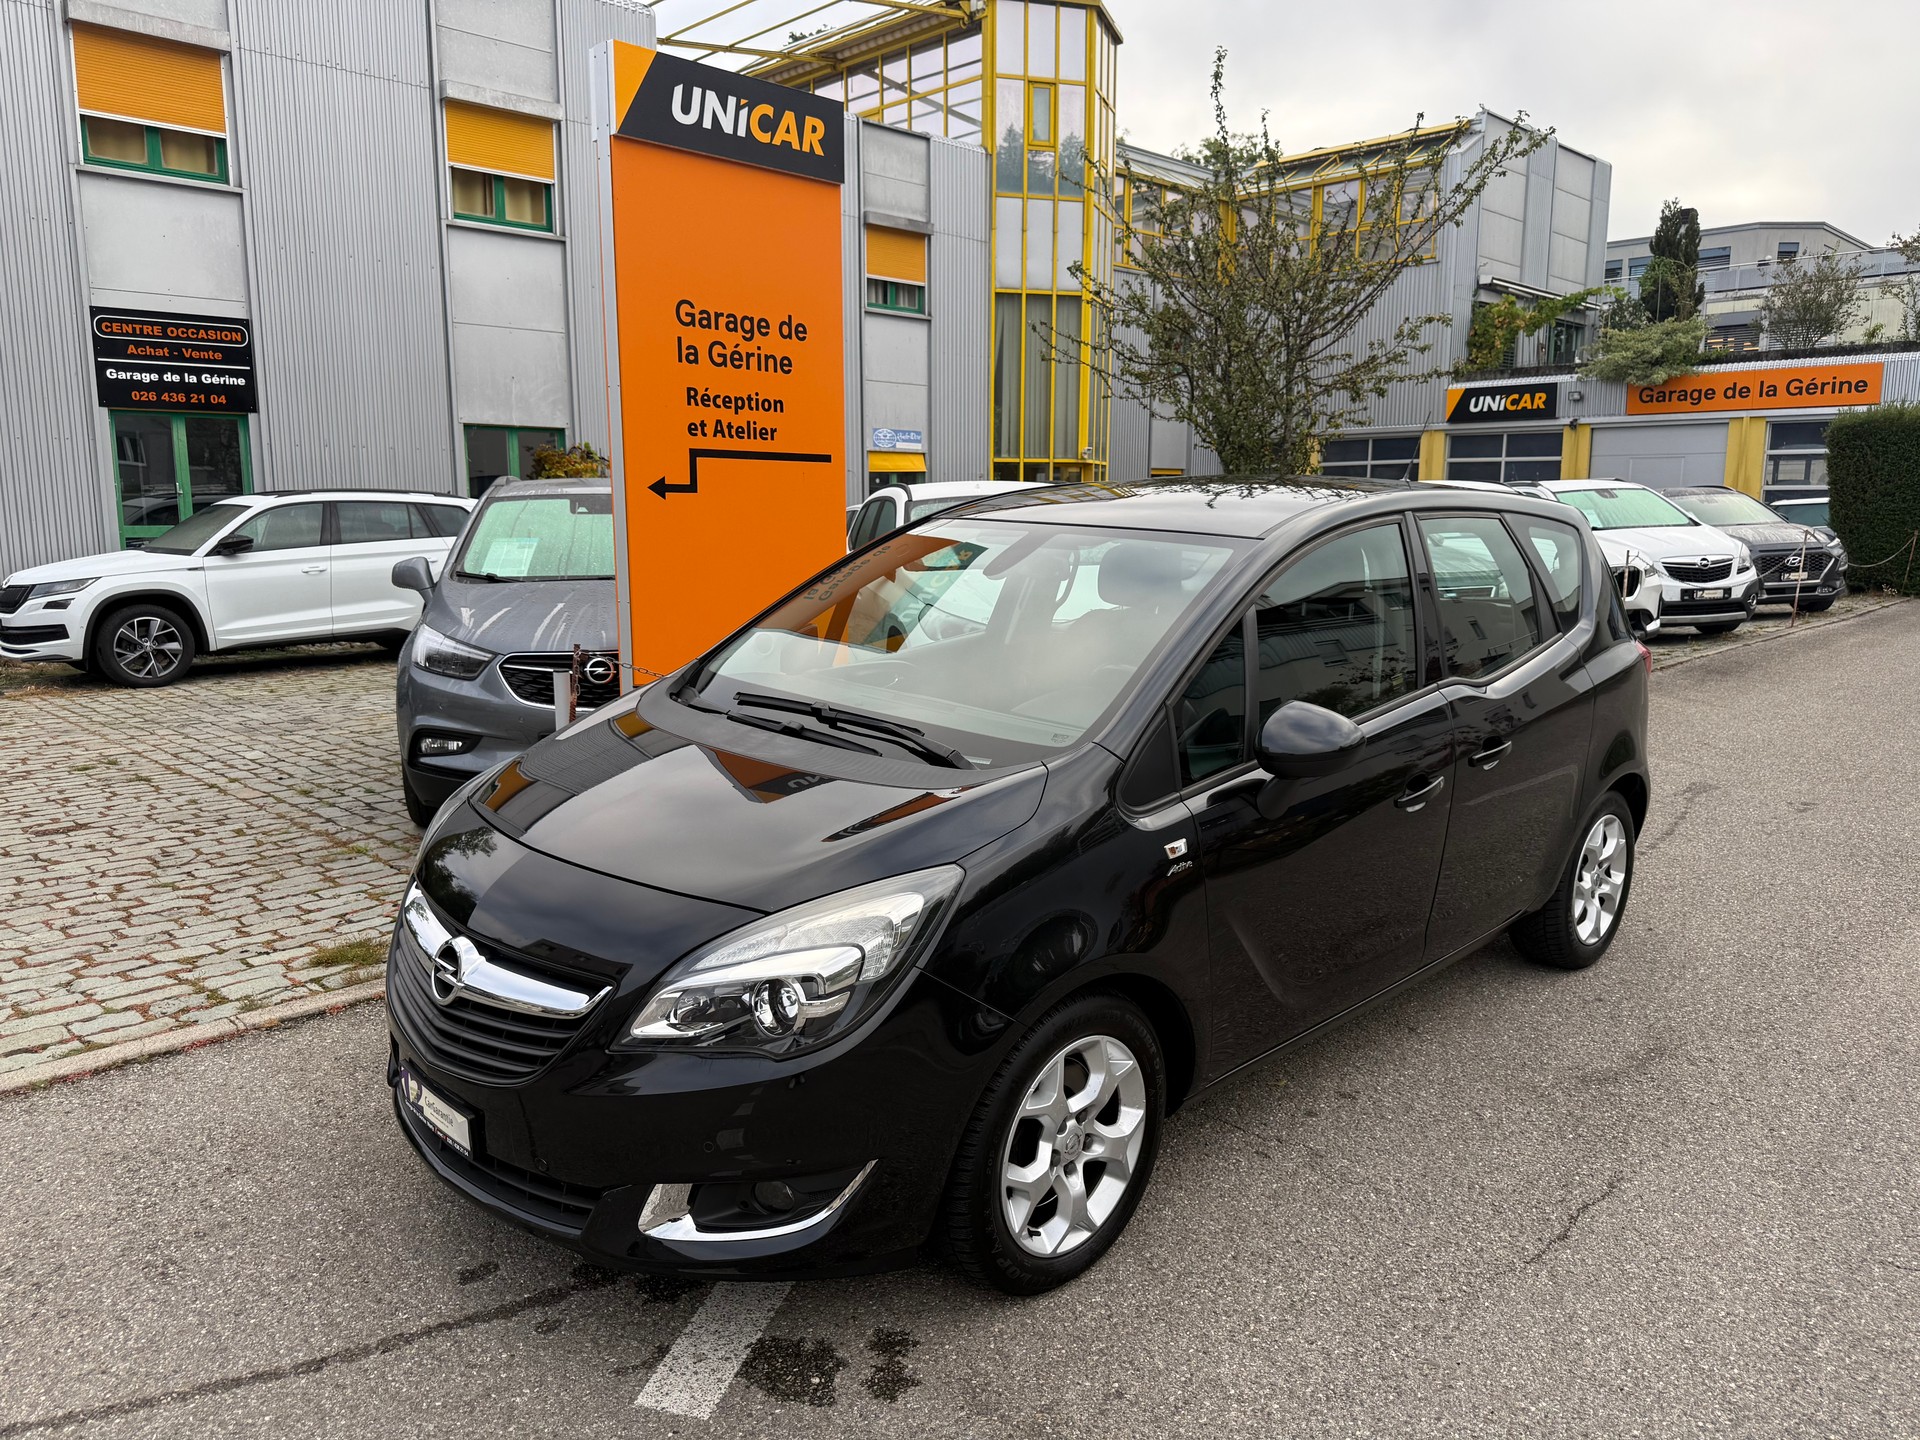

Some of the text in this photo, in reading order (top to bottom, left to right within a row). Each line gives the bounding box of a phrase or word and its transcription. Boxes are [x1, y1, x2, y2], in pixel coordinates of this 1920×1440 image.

[675, 298, 808, 342] Garage de
[101, 321, 242, 342] CENTRE OCCASION
[127, 344, 170, 357] Achat
[182, 347, 223, 360] Vente
[677, 336, 793, 375] la Gérine
[106, 368, 246, 386] Garage de la Gérine
[131, 390, 227, 405] 026 436 21 04
[686, 386, 785, 415] Réception
[1638, 376, 1869, 406] Garage de la Gérine
[687, 419, 778, 441] et Atelier
